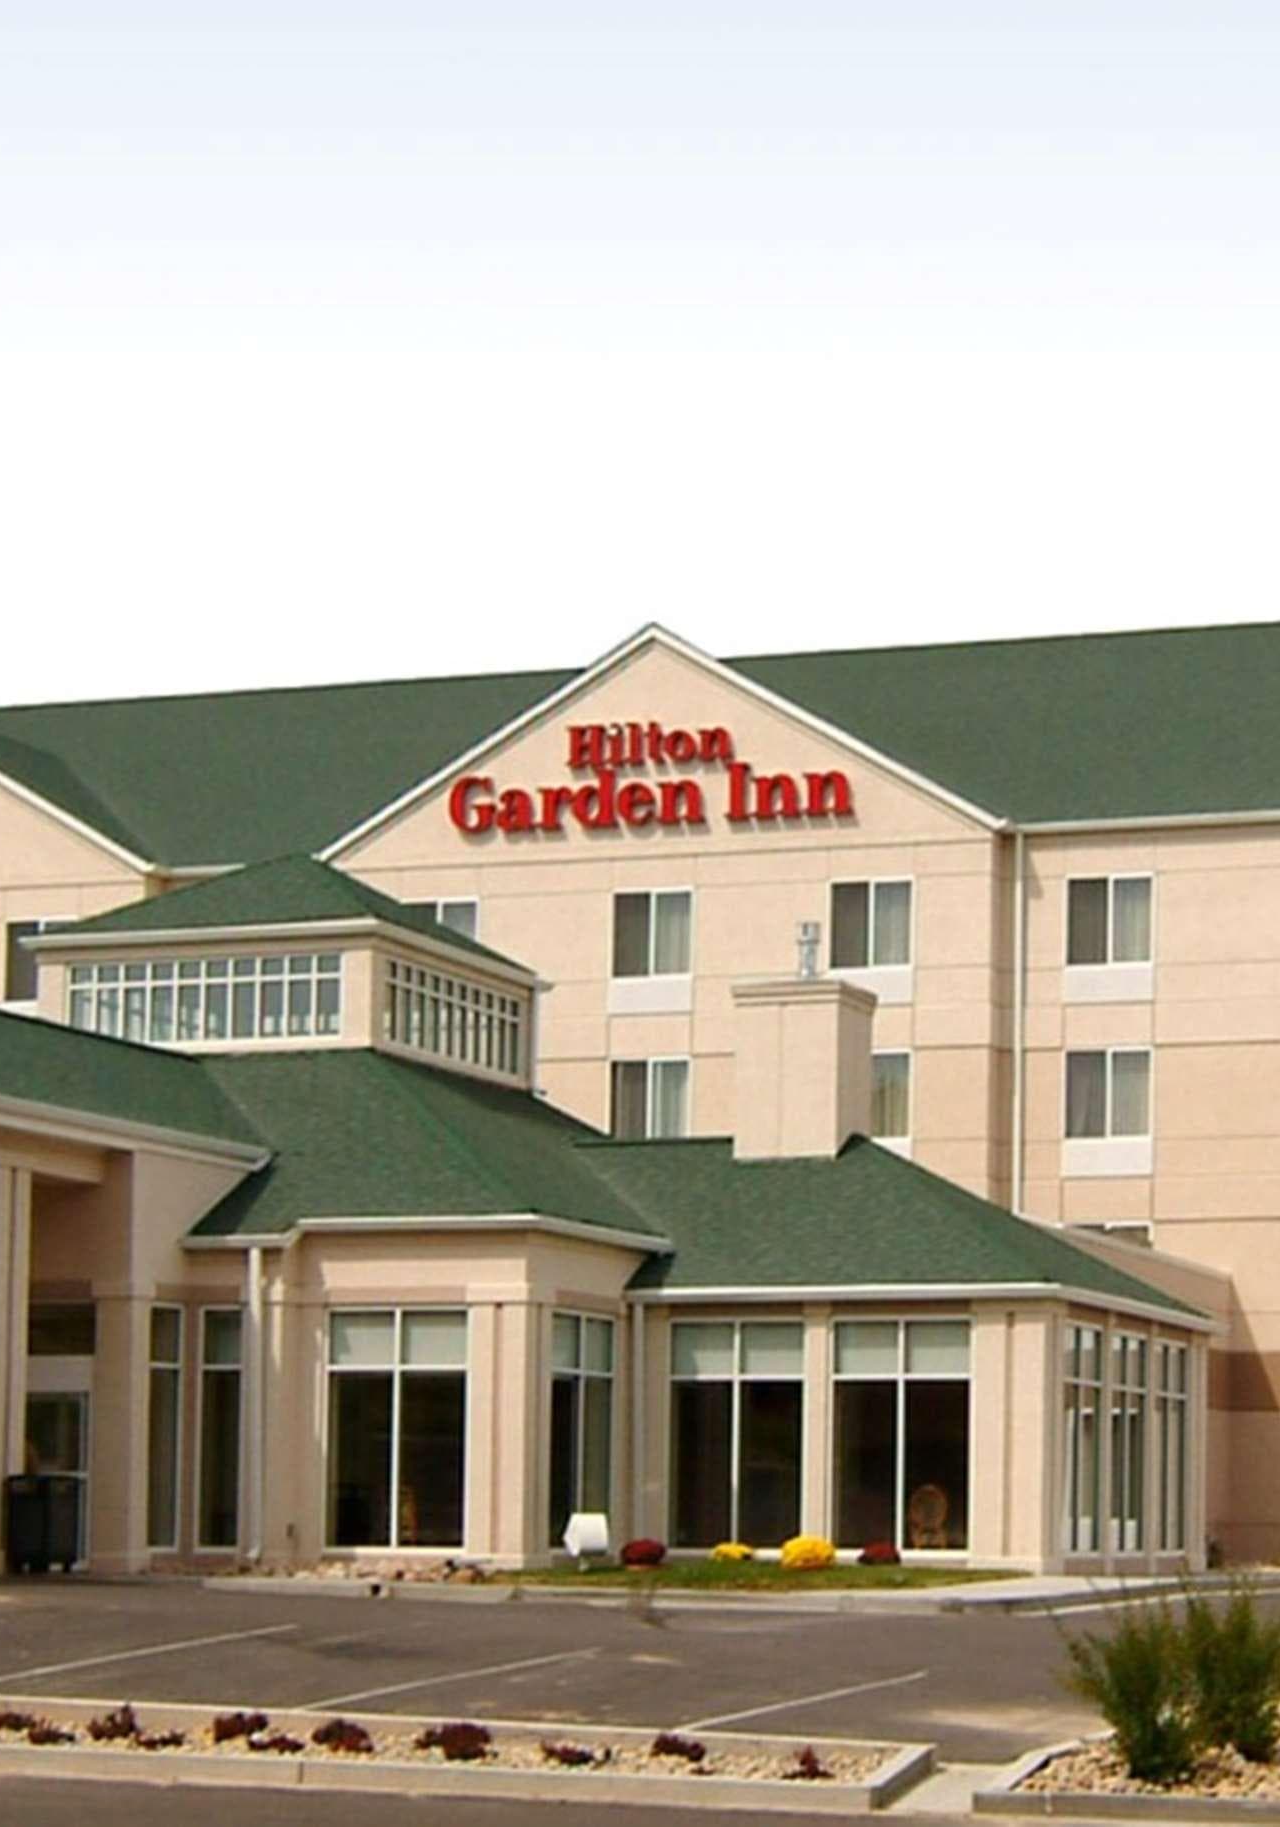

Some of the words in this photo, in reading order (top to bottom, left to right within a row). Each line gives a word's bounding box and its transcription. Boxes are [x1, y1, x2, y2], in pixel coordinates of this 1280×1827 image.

[567, 722, 734, 769] Hilton
[448, 768, 707, 835] Garden
[725, 761, 856, 822] Inn
